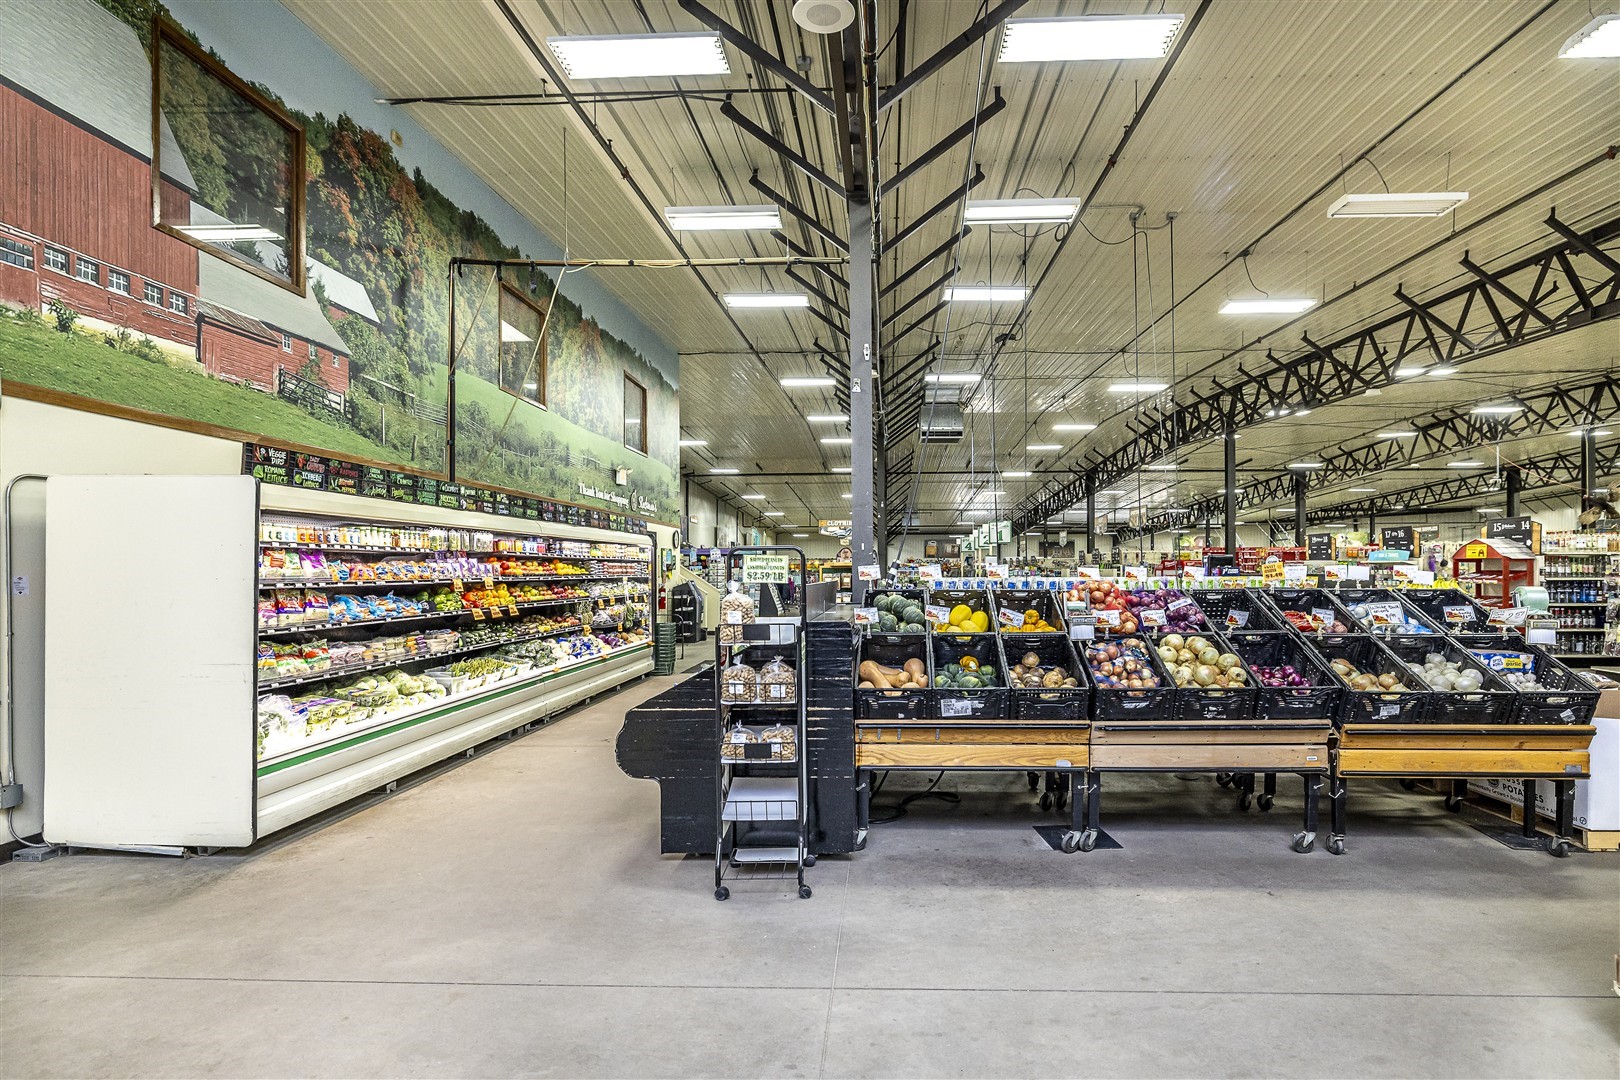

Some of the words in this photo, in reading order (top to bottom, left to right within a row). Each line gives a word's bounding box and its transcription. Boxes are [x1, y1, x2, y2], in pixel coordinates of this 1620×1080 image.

[268, 448, 287, 459] VEGGIE
[271, 457, 285, 465] DIPS
[264, 465, 286, 475] ROMAINE
[263, 473, 288, 484] LETTUCE
[302, 472, 322, 482] ICEBERG
[1493, 523, 1502, 532] 15
[1521, 521, 1530, 529] 14
[998, 530, 1003, 541] 1
[1397, 530, 1405, 538] 16
[965, 542, 972, 550] 4
